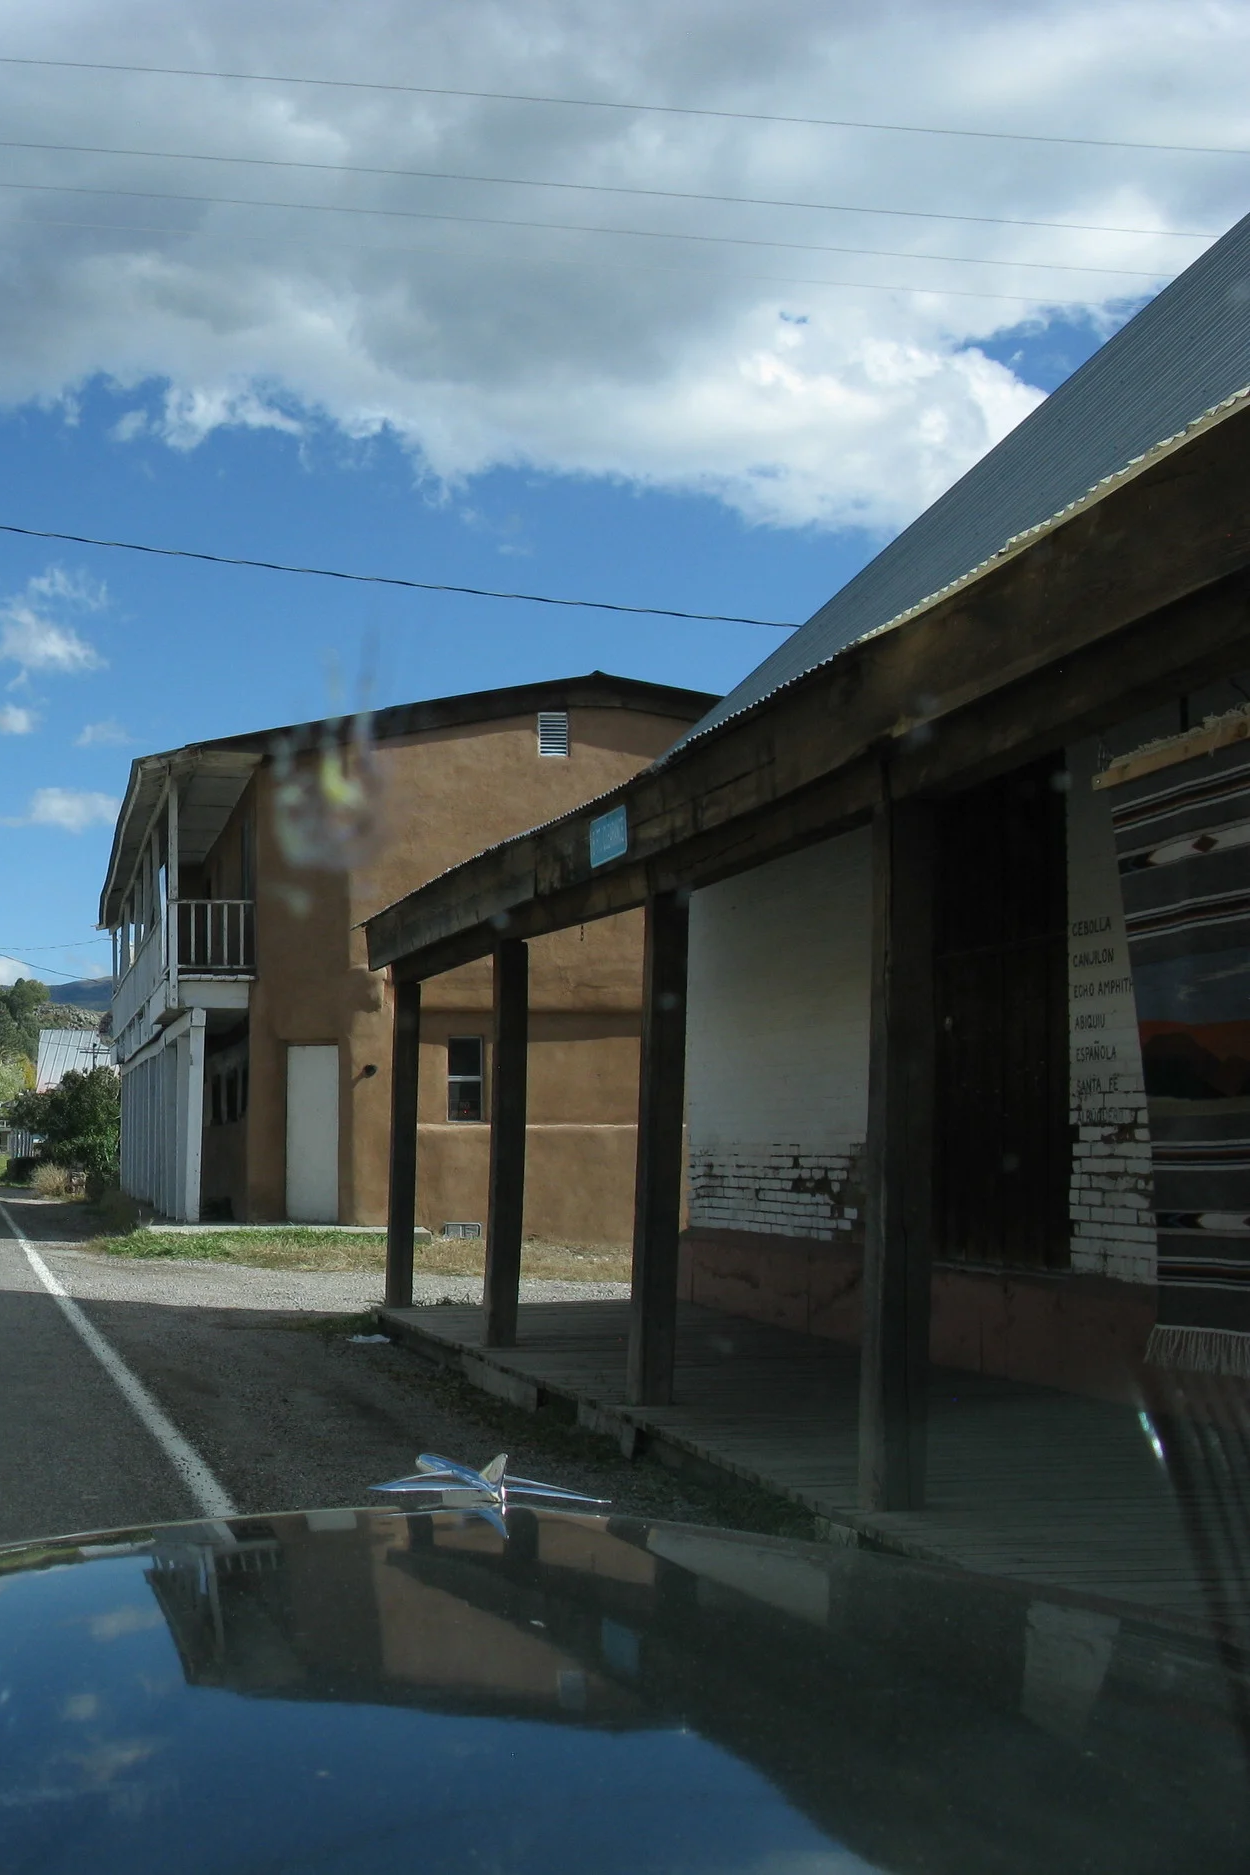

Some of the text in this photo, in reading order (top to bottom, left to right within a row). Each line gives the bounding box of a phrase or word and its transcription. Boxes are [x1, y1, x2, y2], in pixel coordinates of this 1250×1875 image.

[1072, 917, 1112, 937] CEBOLLA
[1073, 982, 1095, 998] ECHO
[1075, 1014, 1105, 1030] ABIQUIU
[1076, 1041, 1117, 1062] ESPAÑOLA
[1077, 1077, 1102, 1093] SANTA
